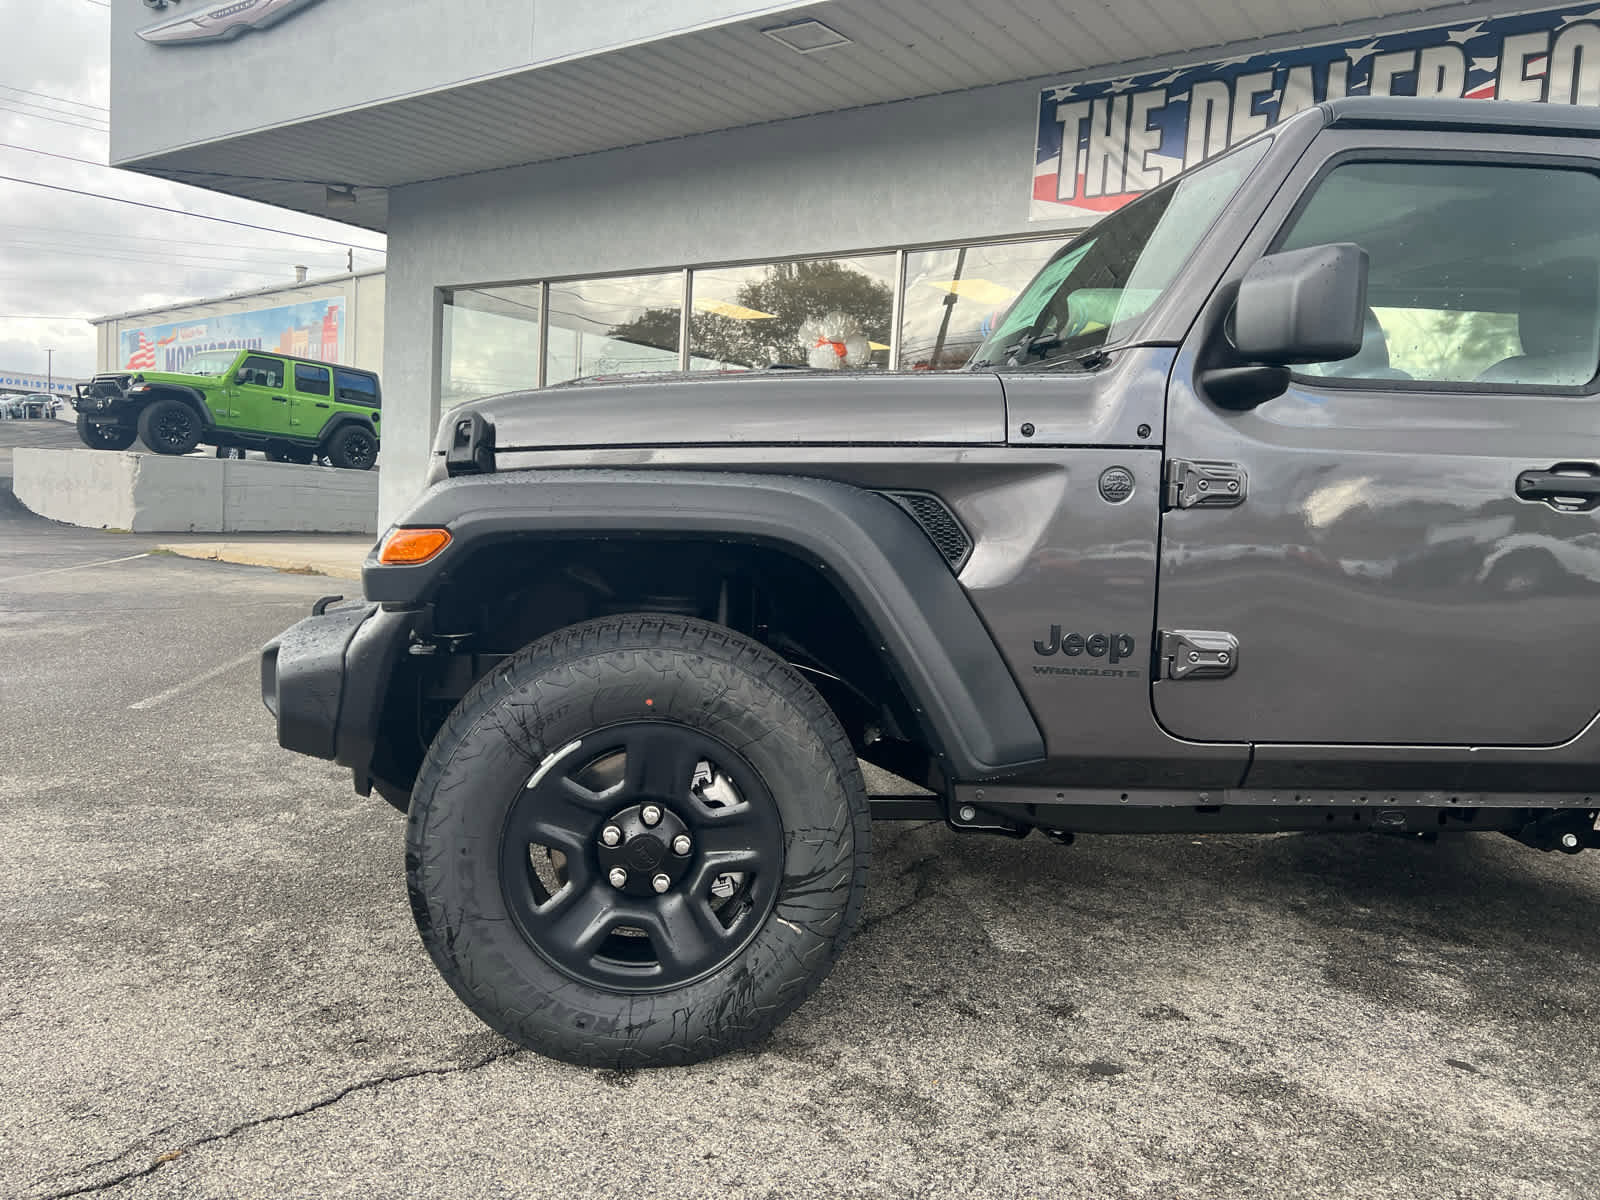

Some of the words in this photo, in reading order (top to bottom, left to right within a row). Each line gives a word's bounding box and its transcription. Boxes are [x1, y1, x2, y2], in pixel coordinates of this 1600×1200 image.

[1055, 88, 1168, 200] THE
[1034, 624, 1135, 664] Jeep
[1032, 665, 1123, 678] WRANGLER
